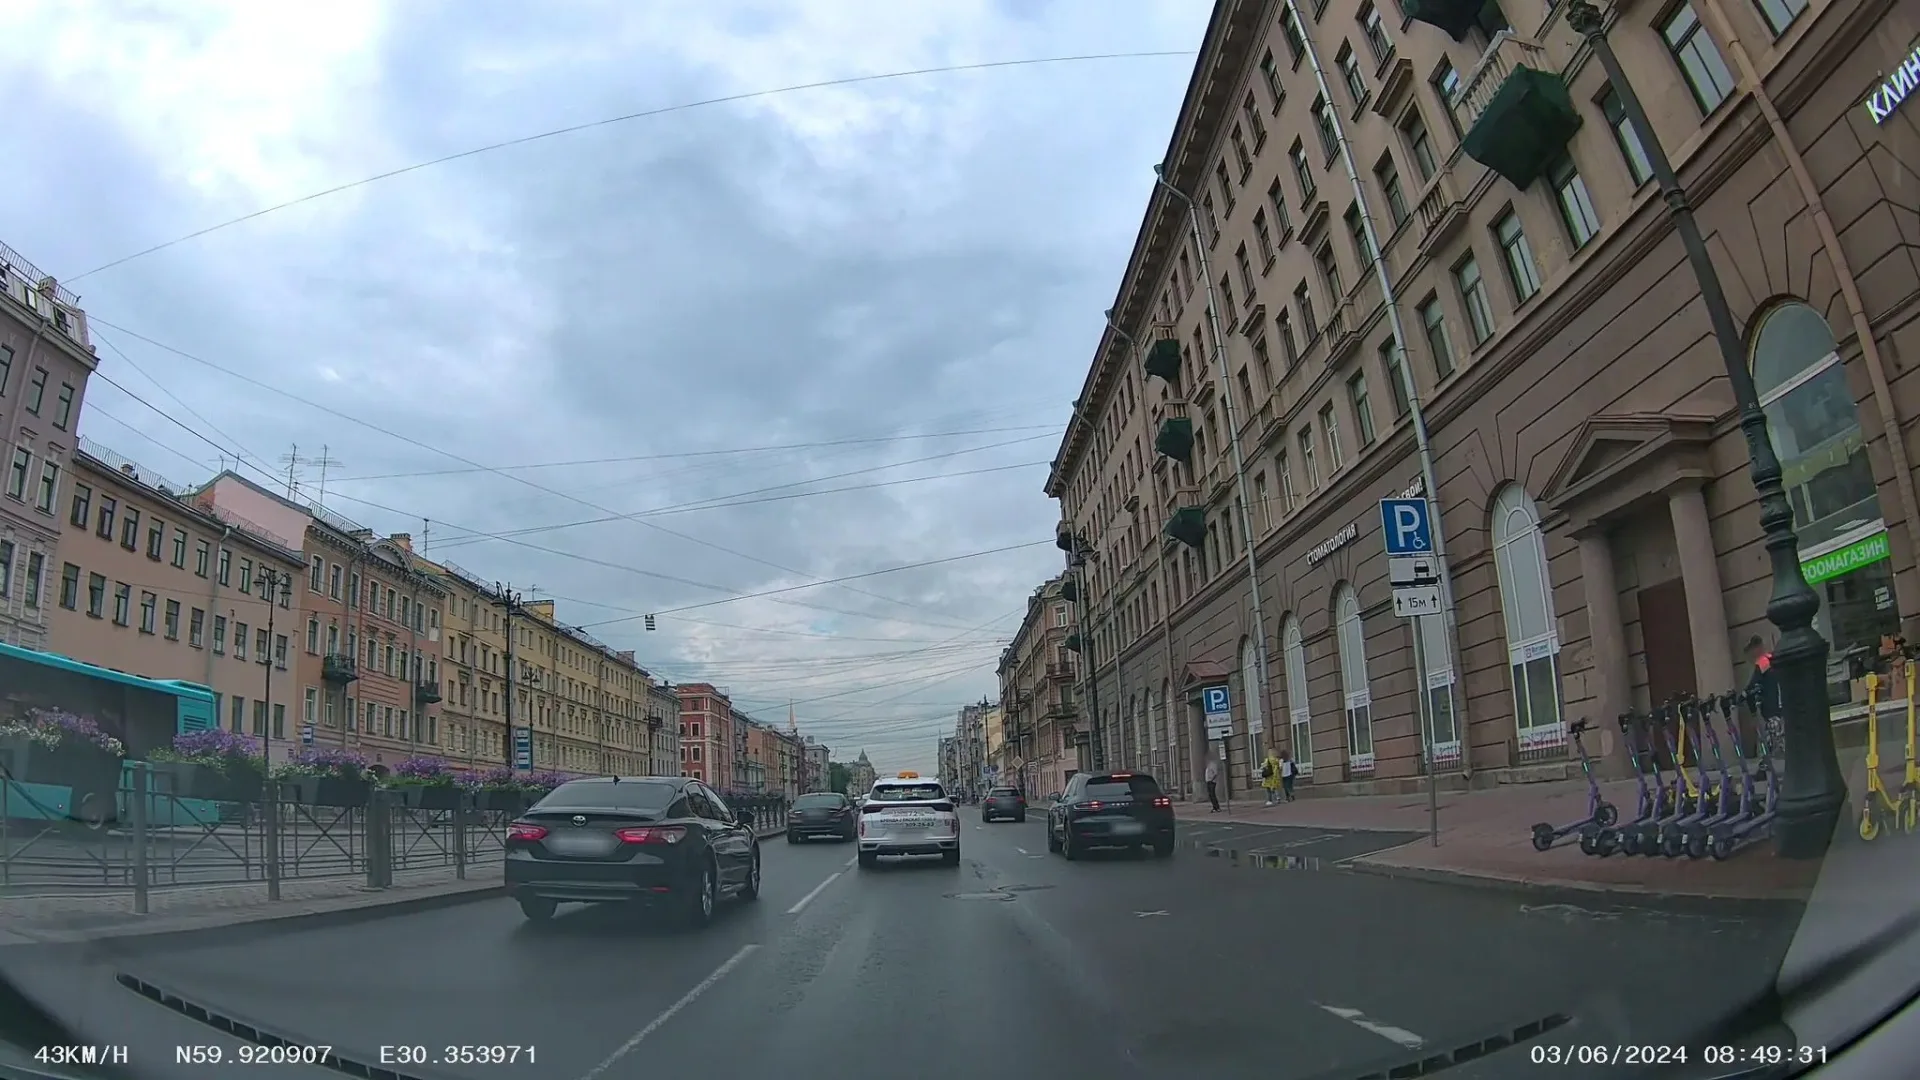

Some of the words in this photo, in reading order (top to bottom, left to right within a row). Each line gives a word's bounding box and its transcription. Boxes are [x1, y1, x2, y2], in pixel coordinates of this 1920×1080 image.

[1866, 46, 1920, 124] КЛИН
[1307, 523, 1357, 565] СТОМАТОЛОГИЯ
[1394, 505, 1420, 548] P
[1209, 689, 1224, 710] P
